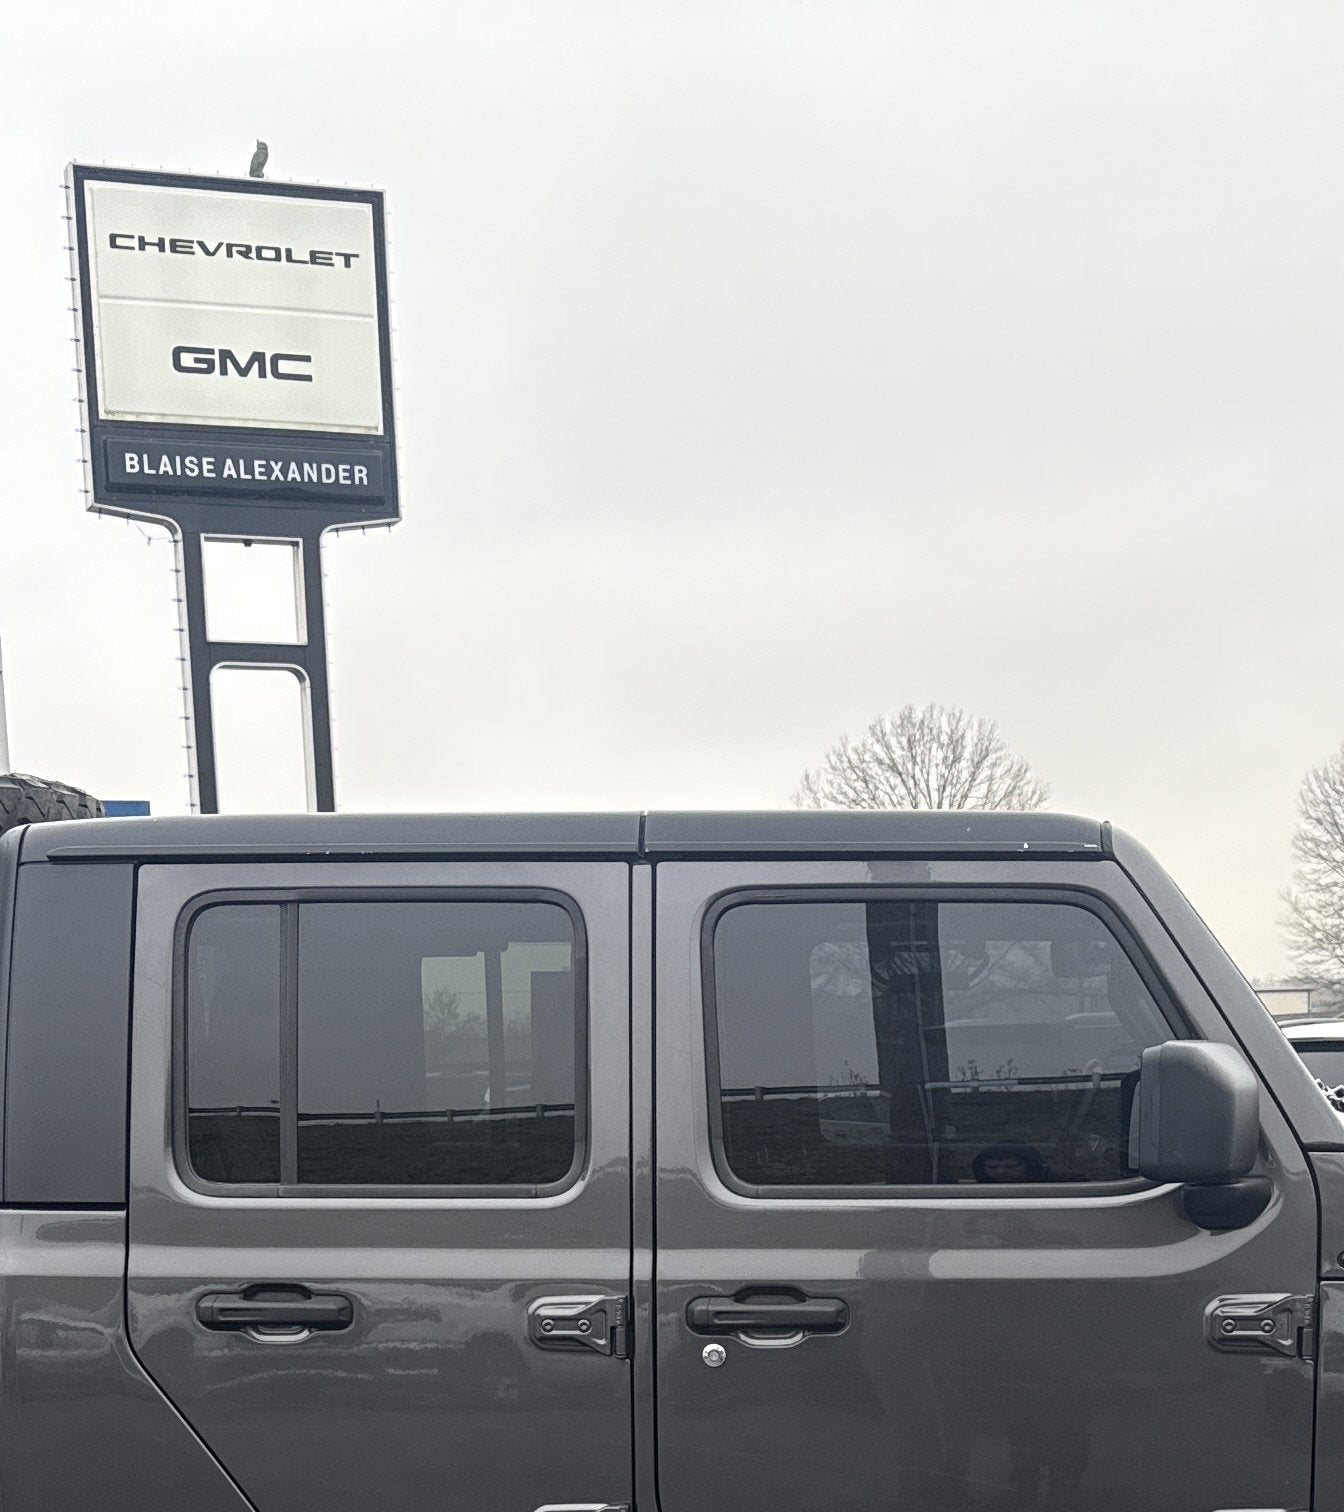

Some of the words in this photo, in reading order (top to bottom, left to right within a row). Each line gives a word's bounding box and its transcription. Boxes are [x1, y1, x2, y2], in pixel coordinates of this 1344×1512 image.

[109, 232, 360, 268] CHEVROLET
[172, 345, 313, 382] GMC
[124, 453, 216, 479] BLAISE
[223, 458, 368, 486] ALEXANDER
